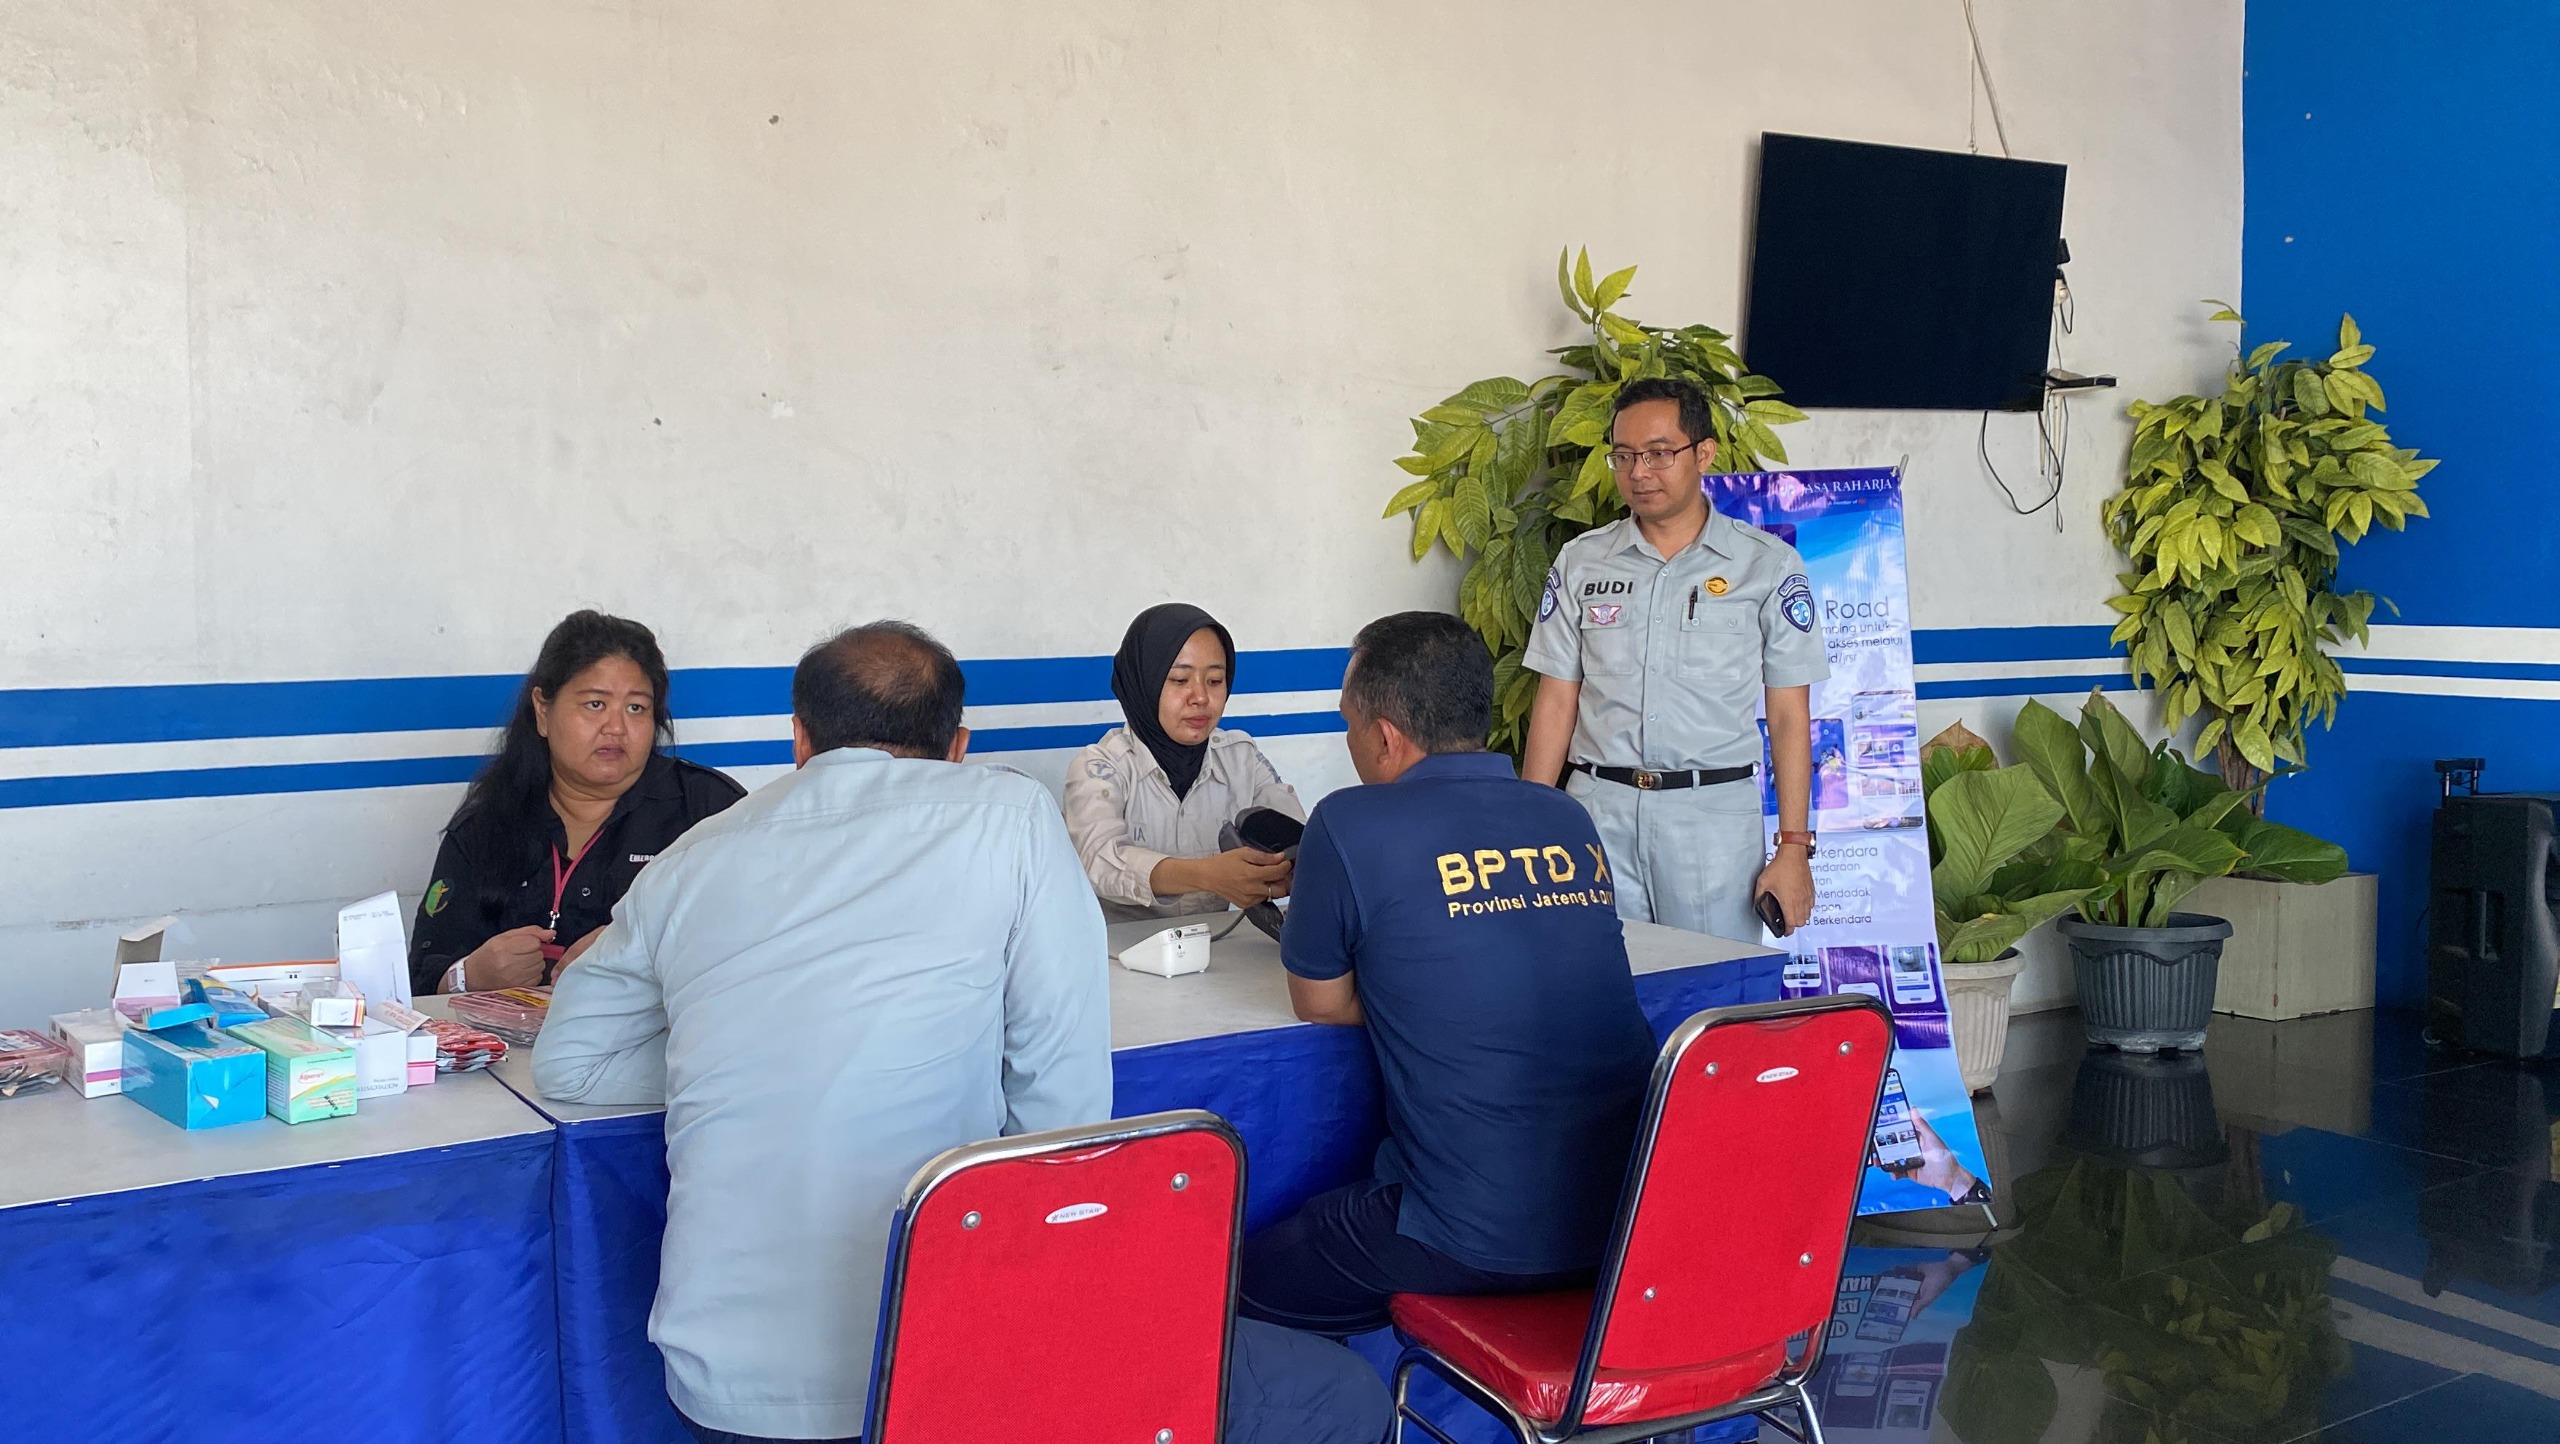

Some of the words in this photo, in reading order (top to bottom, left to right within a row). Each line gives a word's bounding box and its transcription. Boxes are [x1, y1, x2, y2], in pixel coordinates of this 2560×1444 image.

[1833, 478, 1893, 492] RAHARJA
[1583, 581, 1634, 596] BUDI
[1825, 596, 1889, 619] Road
[1821, 624, 1857, 636] mping
[1860, 622, 1893, 633] untuk
[1828, 637, 1858, 649] akses
[1861, 636, 1903, 647] melalui
[1814, 846, 1878, 859] rkendara
[1436, 845, 1576, 896] BPTD
[1810, 862, 1861, 873] endaraan
[1815, 877, 1833, 886] tan
[1448, 894, 1528, 918] Provinsi
[1532, 891, 1588, 908] Jateng
[1588, 888, 1599, 904] &
[1815, 902, 1842, 913] epon
[1813, 915, 1872, 926] Berkendara
[1060, 1211, 1078, 1219] NEW
